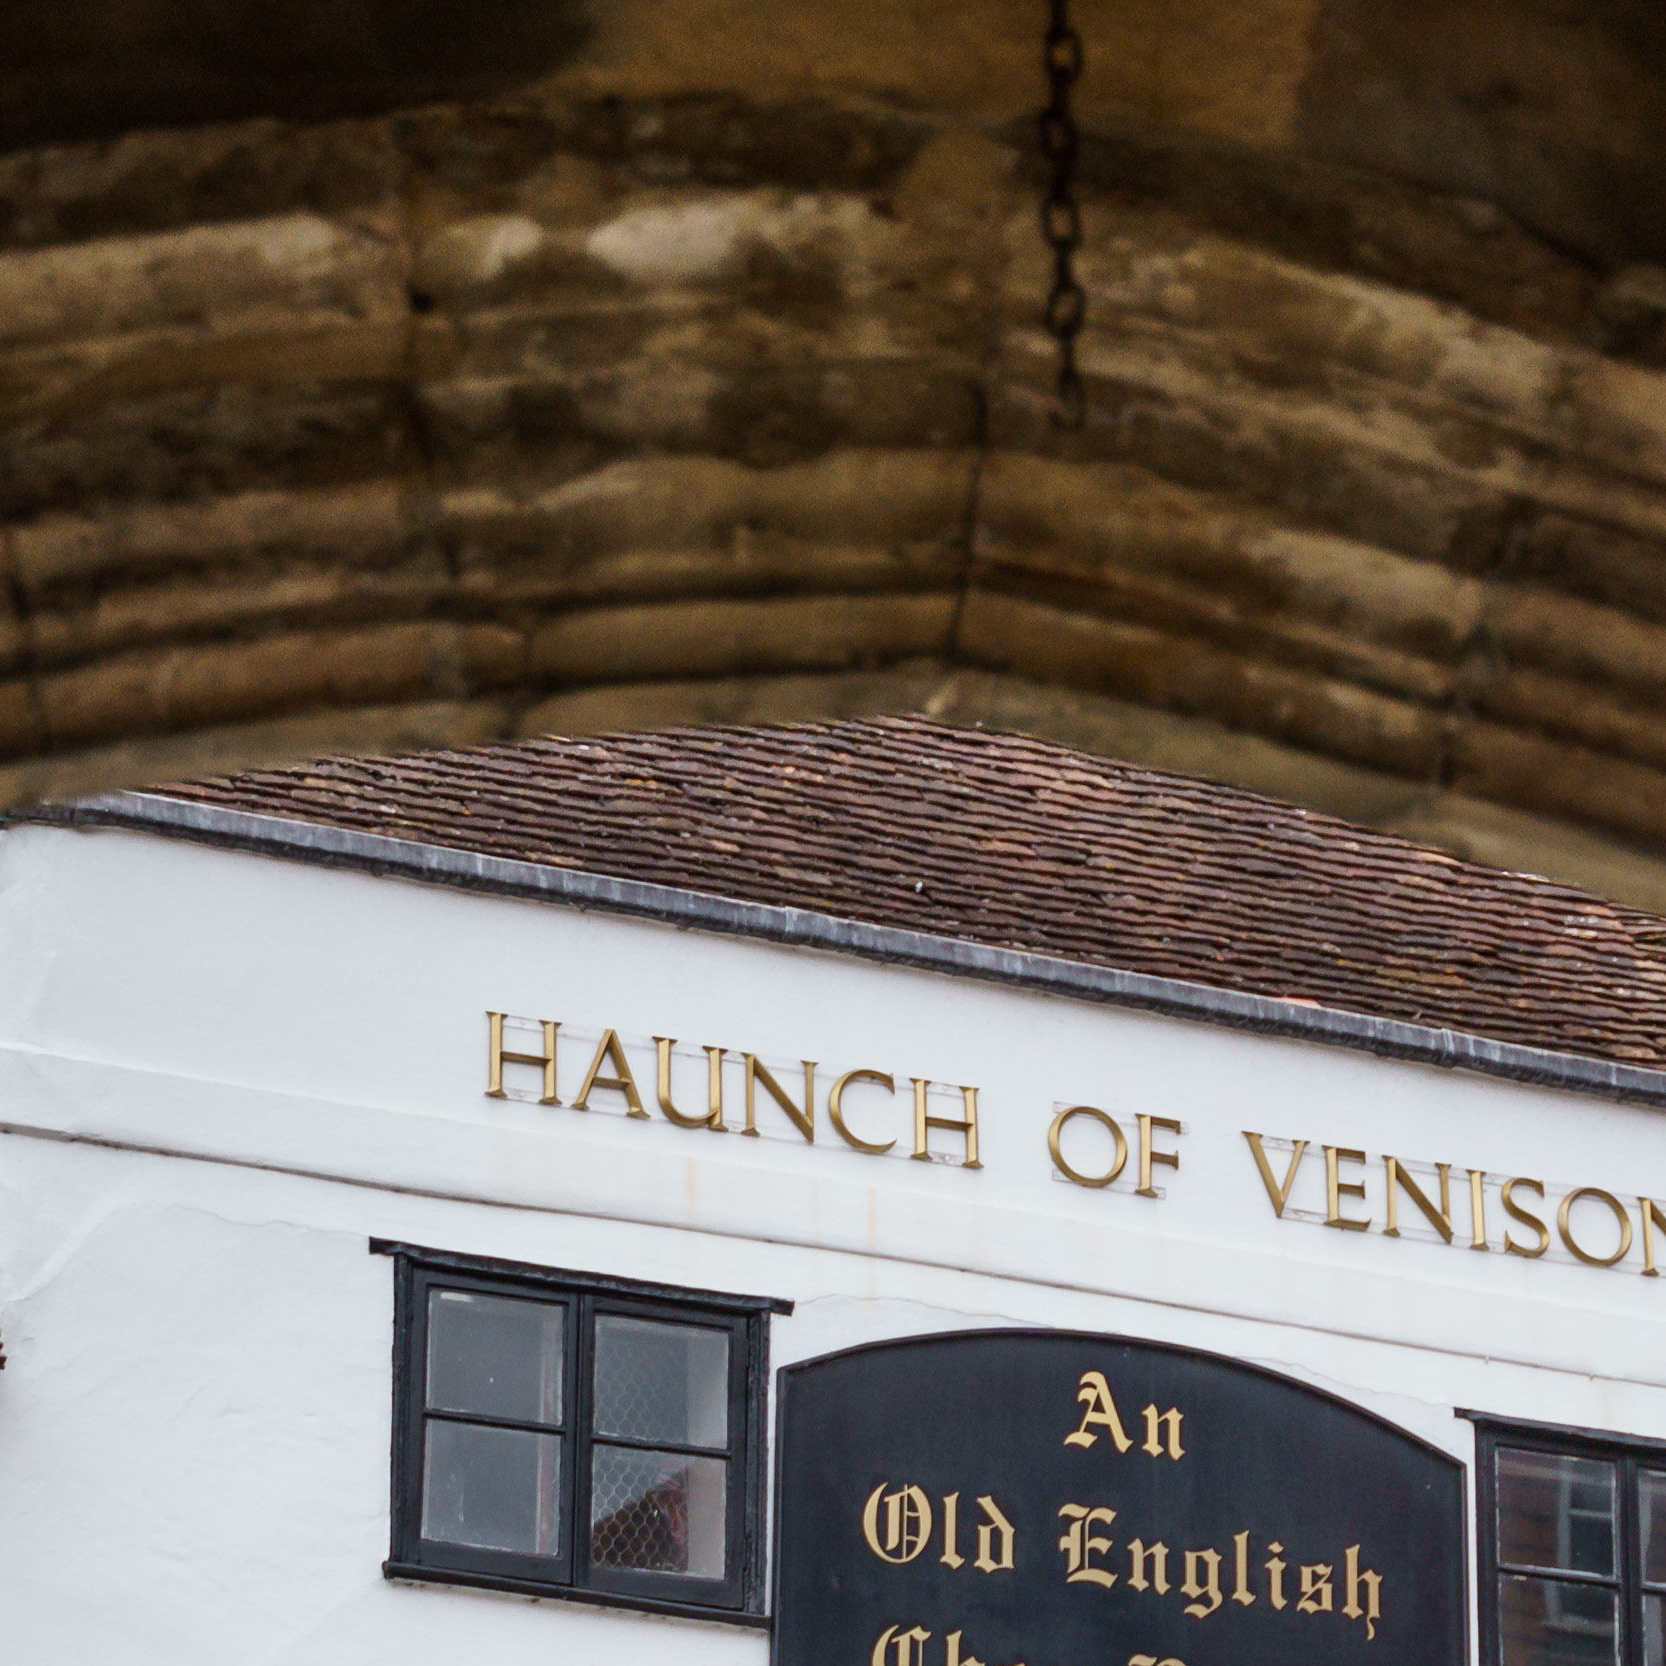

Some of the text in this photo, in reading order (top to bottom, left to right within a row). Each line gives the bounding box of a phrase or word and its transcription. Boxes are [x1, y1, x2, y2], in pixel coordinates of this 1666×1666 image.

[485, 1010, 985, 1169] HAUNCH
[1047, 1105, 1182, 1198] OF
[1063, 1370, 1186, 1461] An
[862, 1481, 1383, 1641] Old English
